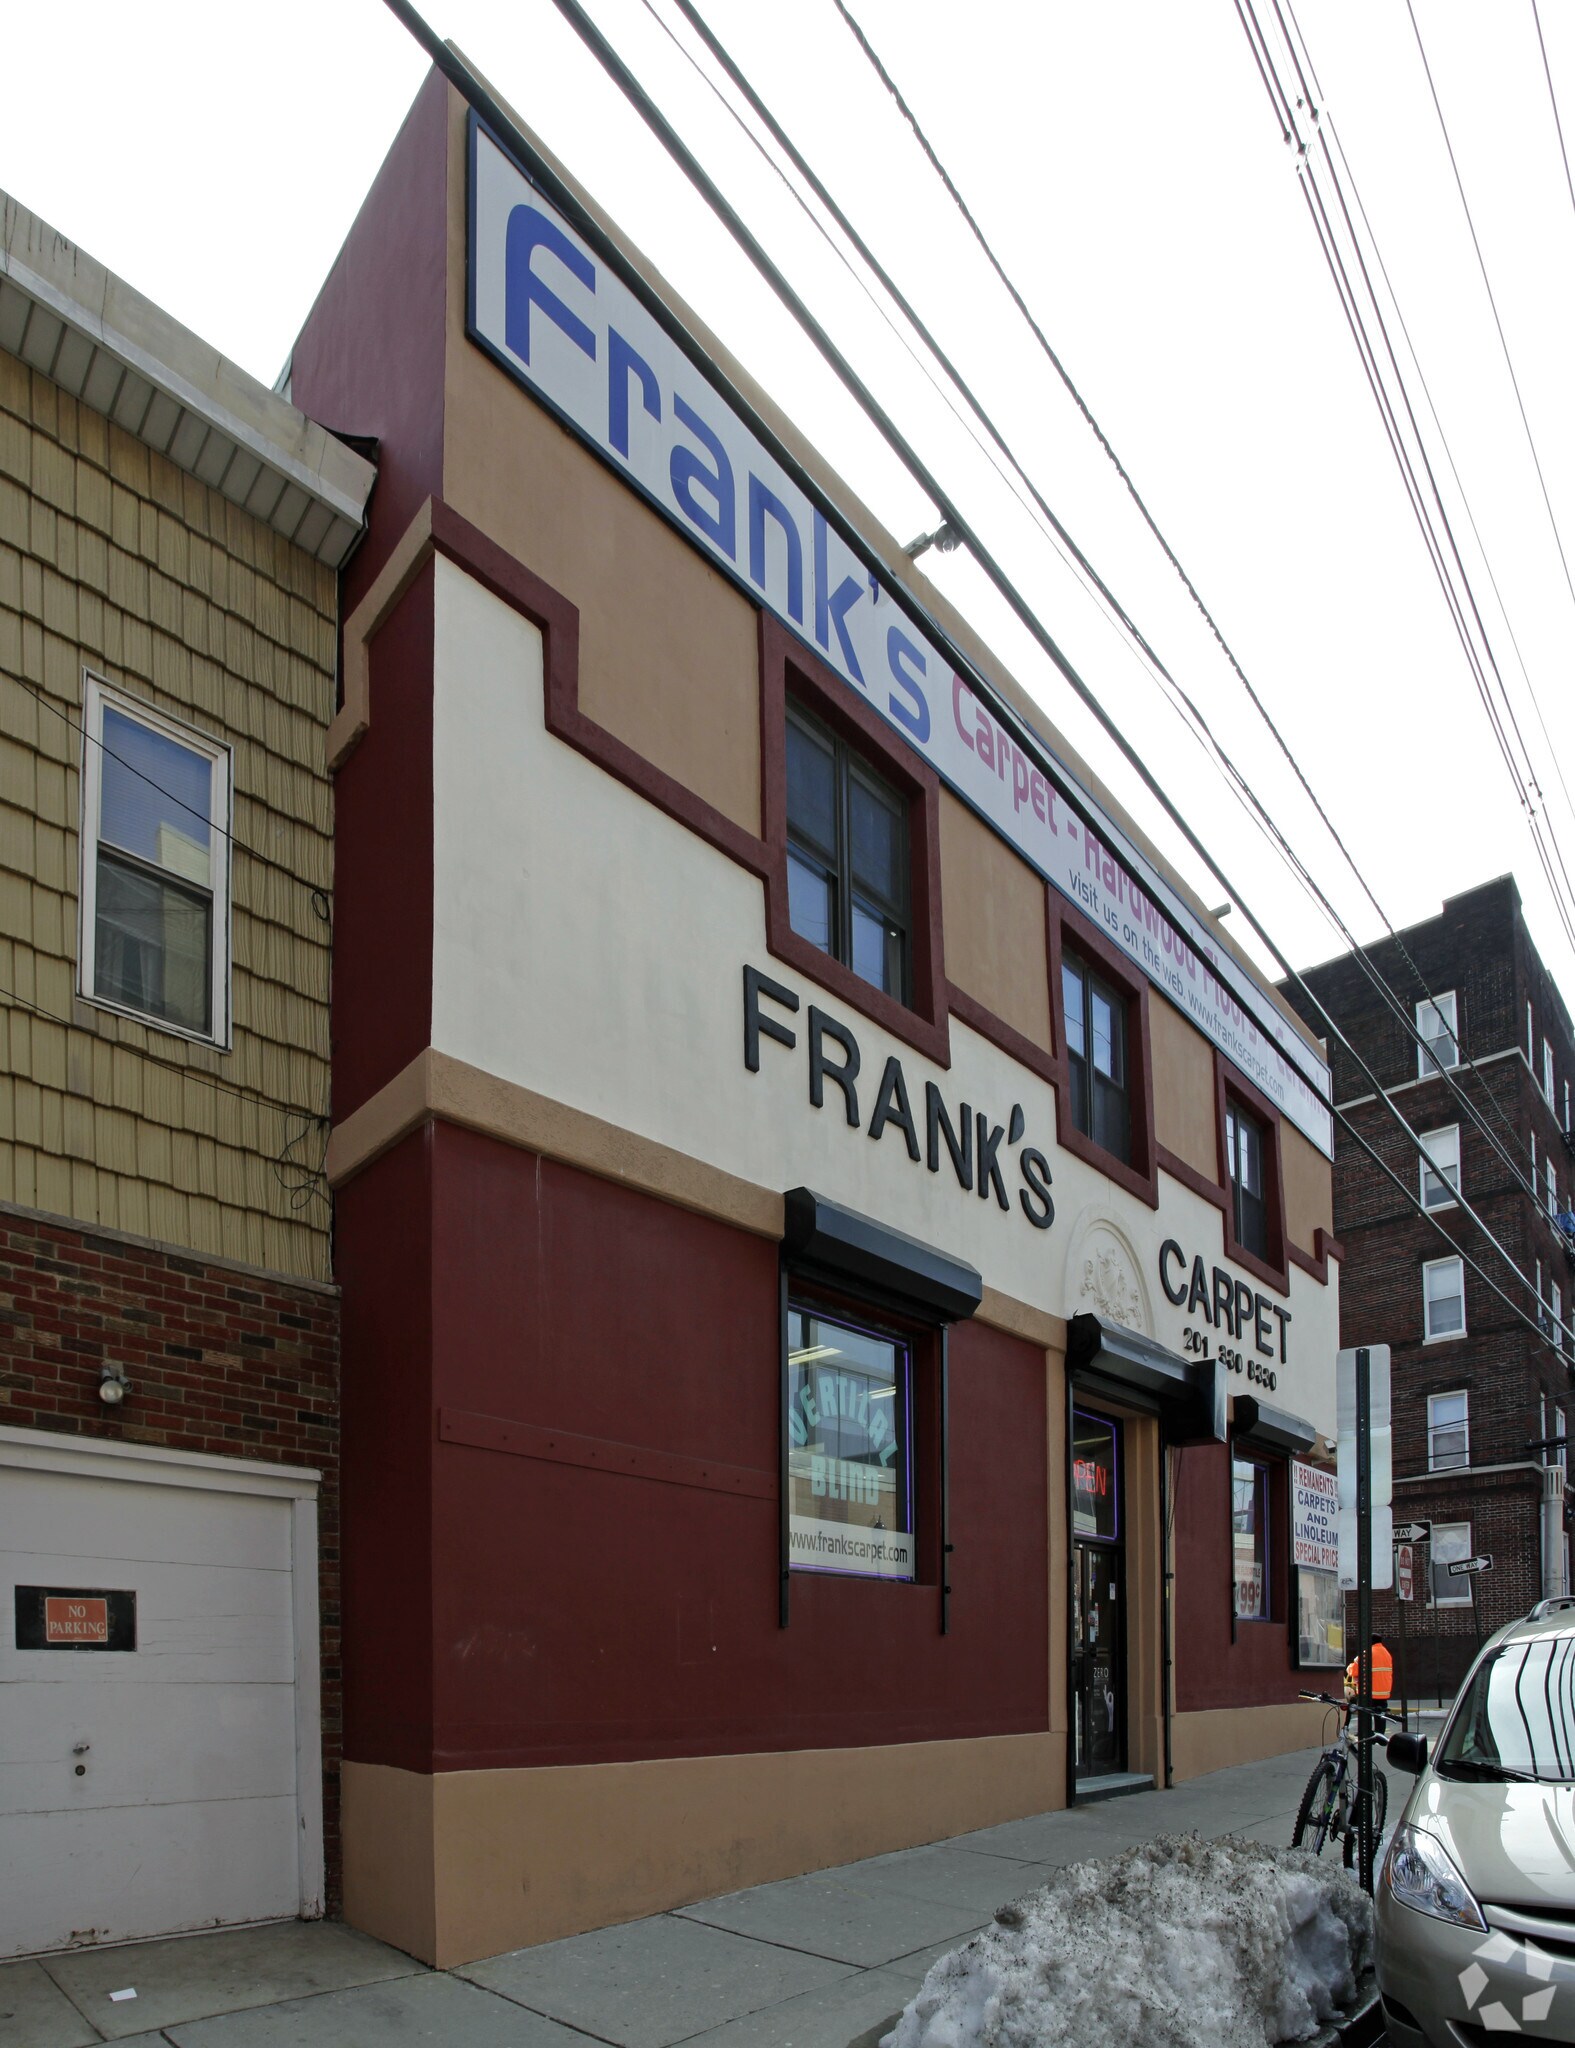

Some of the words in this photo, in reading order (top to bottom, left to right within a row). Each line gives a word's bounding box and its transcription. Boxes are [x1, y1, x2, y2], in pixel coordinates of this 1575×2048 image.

[504, 203, 930, 744] Frank's
[952, 673, 1058, 838] Carpet
[1069, 868, 1099, 914] visit
[1103, 902, 1119, 932] us
[1123, 923, 1138, 951] on
[1142, 935, 1161, 973] the
[1188, 990, 1285, 1102] www.frankscarpet.com
[743, 963, 1056, 1230] FRANK'S
[1158, 1239, 1292, 1364] CARPET
[1183, 1326, 1209, 1358] 201
[1218, 1344, 1244, 1374] 330
[811, 1455, 880, 1507] BLIND
[1299, 1466, 1334, 1497] REMANENTS
[1297, 1490, 1336, 1515] CARPETS
[1306, 1512, 1328, 1526] AND
[1295, 1523, 1339, 1546] LINOLEUM
[1393, 1528, 1412, 1538] WAY
[1295, 1541, 1321, 1566] SPECIAL
[1451, 1564, 1464, 1573] ONE
[1466, 1561, 1479, 1570] WAY
[68, 1605, 86, 1618] NO
[49, 1621, 105, 1635] PARKING
[1093, 1667, 1109, 1678] ZERO
